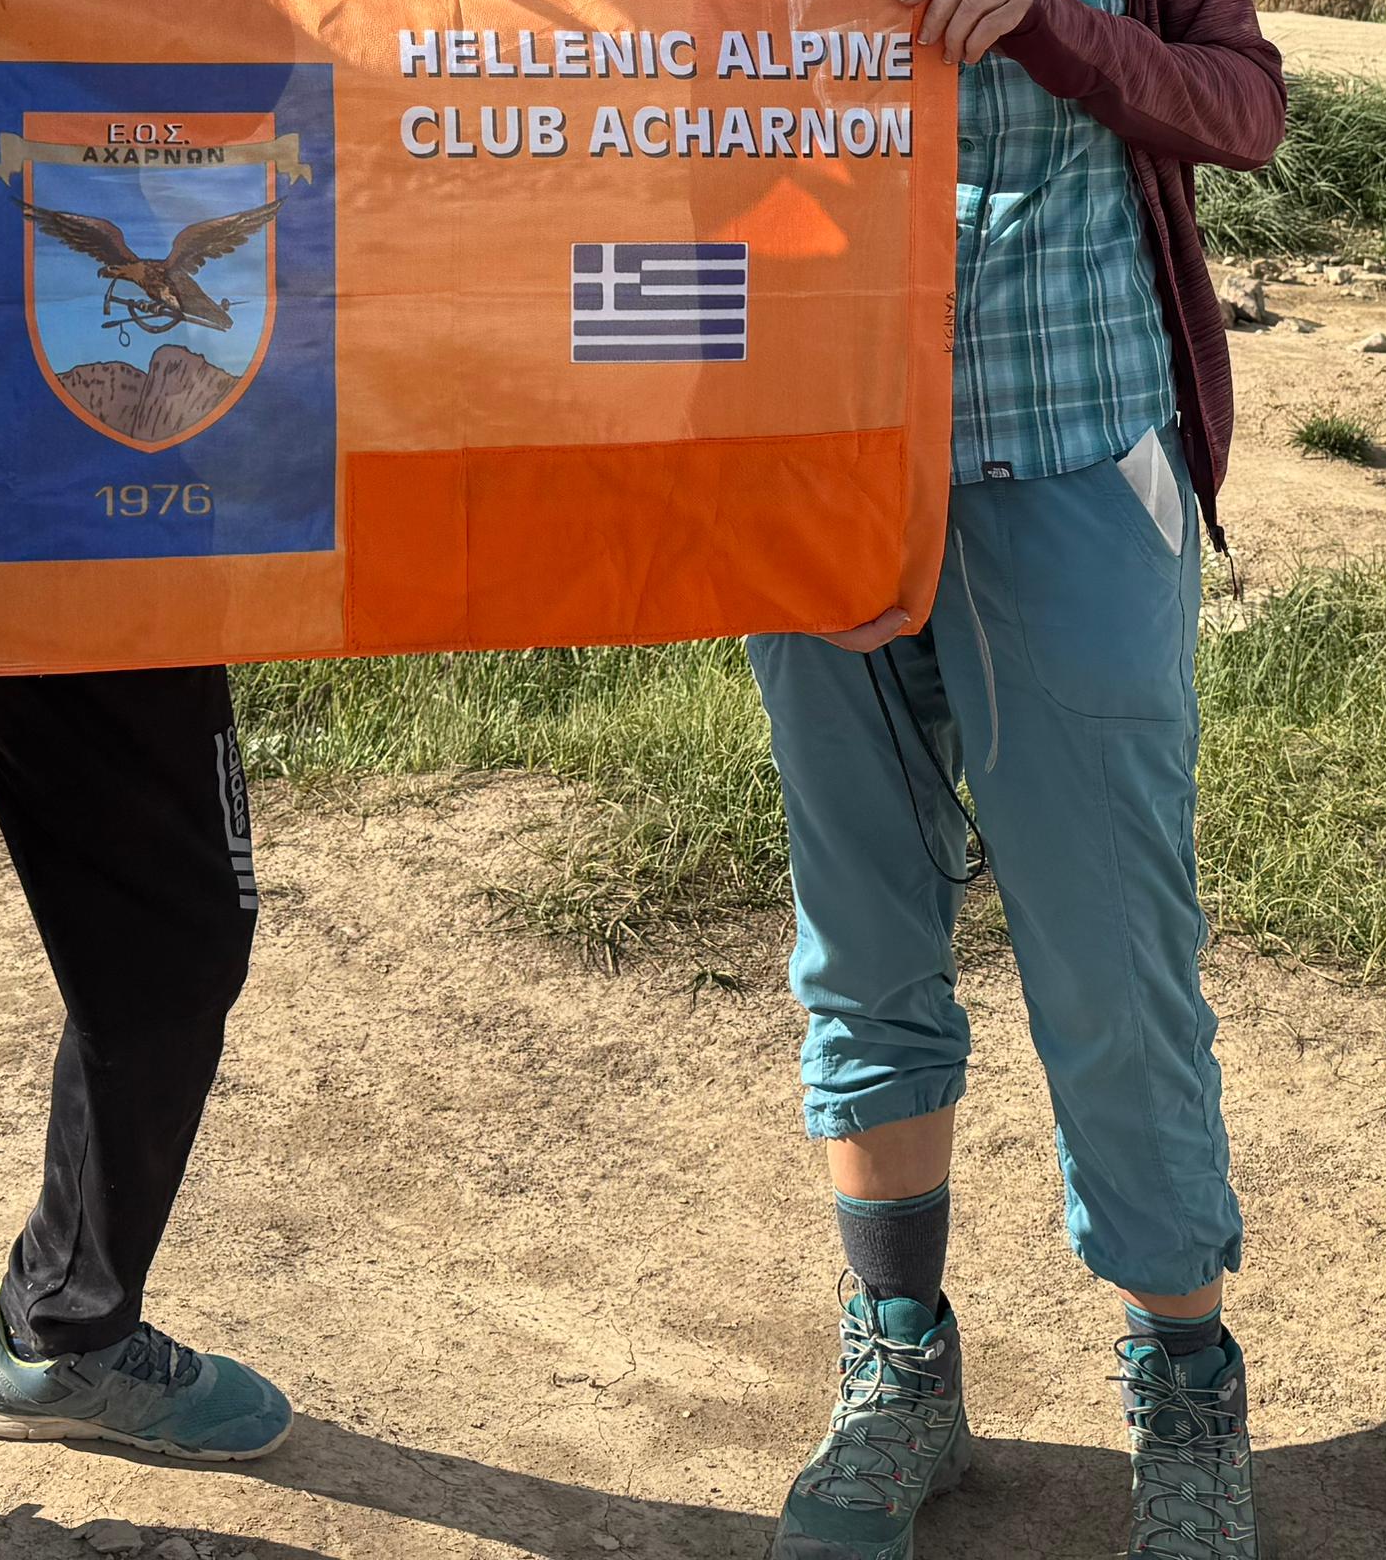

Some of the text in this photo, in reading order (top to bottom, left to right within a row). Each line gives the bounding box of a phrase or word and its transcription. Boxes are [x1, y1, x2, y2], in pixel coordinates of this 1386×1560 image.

[398, 29, 913, 80] HELLENIC ALPINE
[400, 105, 913, 158] CLUB ACHARNON
[95, 483, 212, 517] 1976
